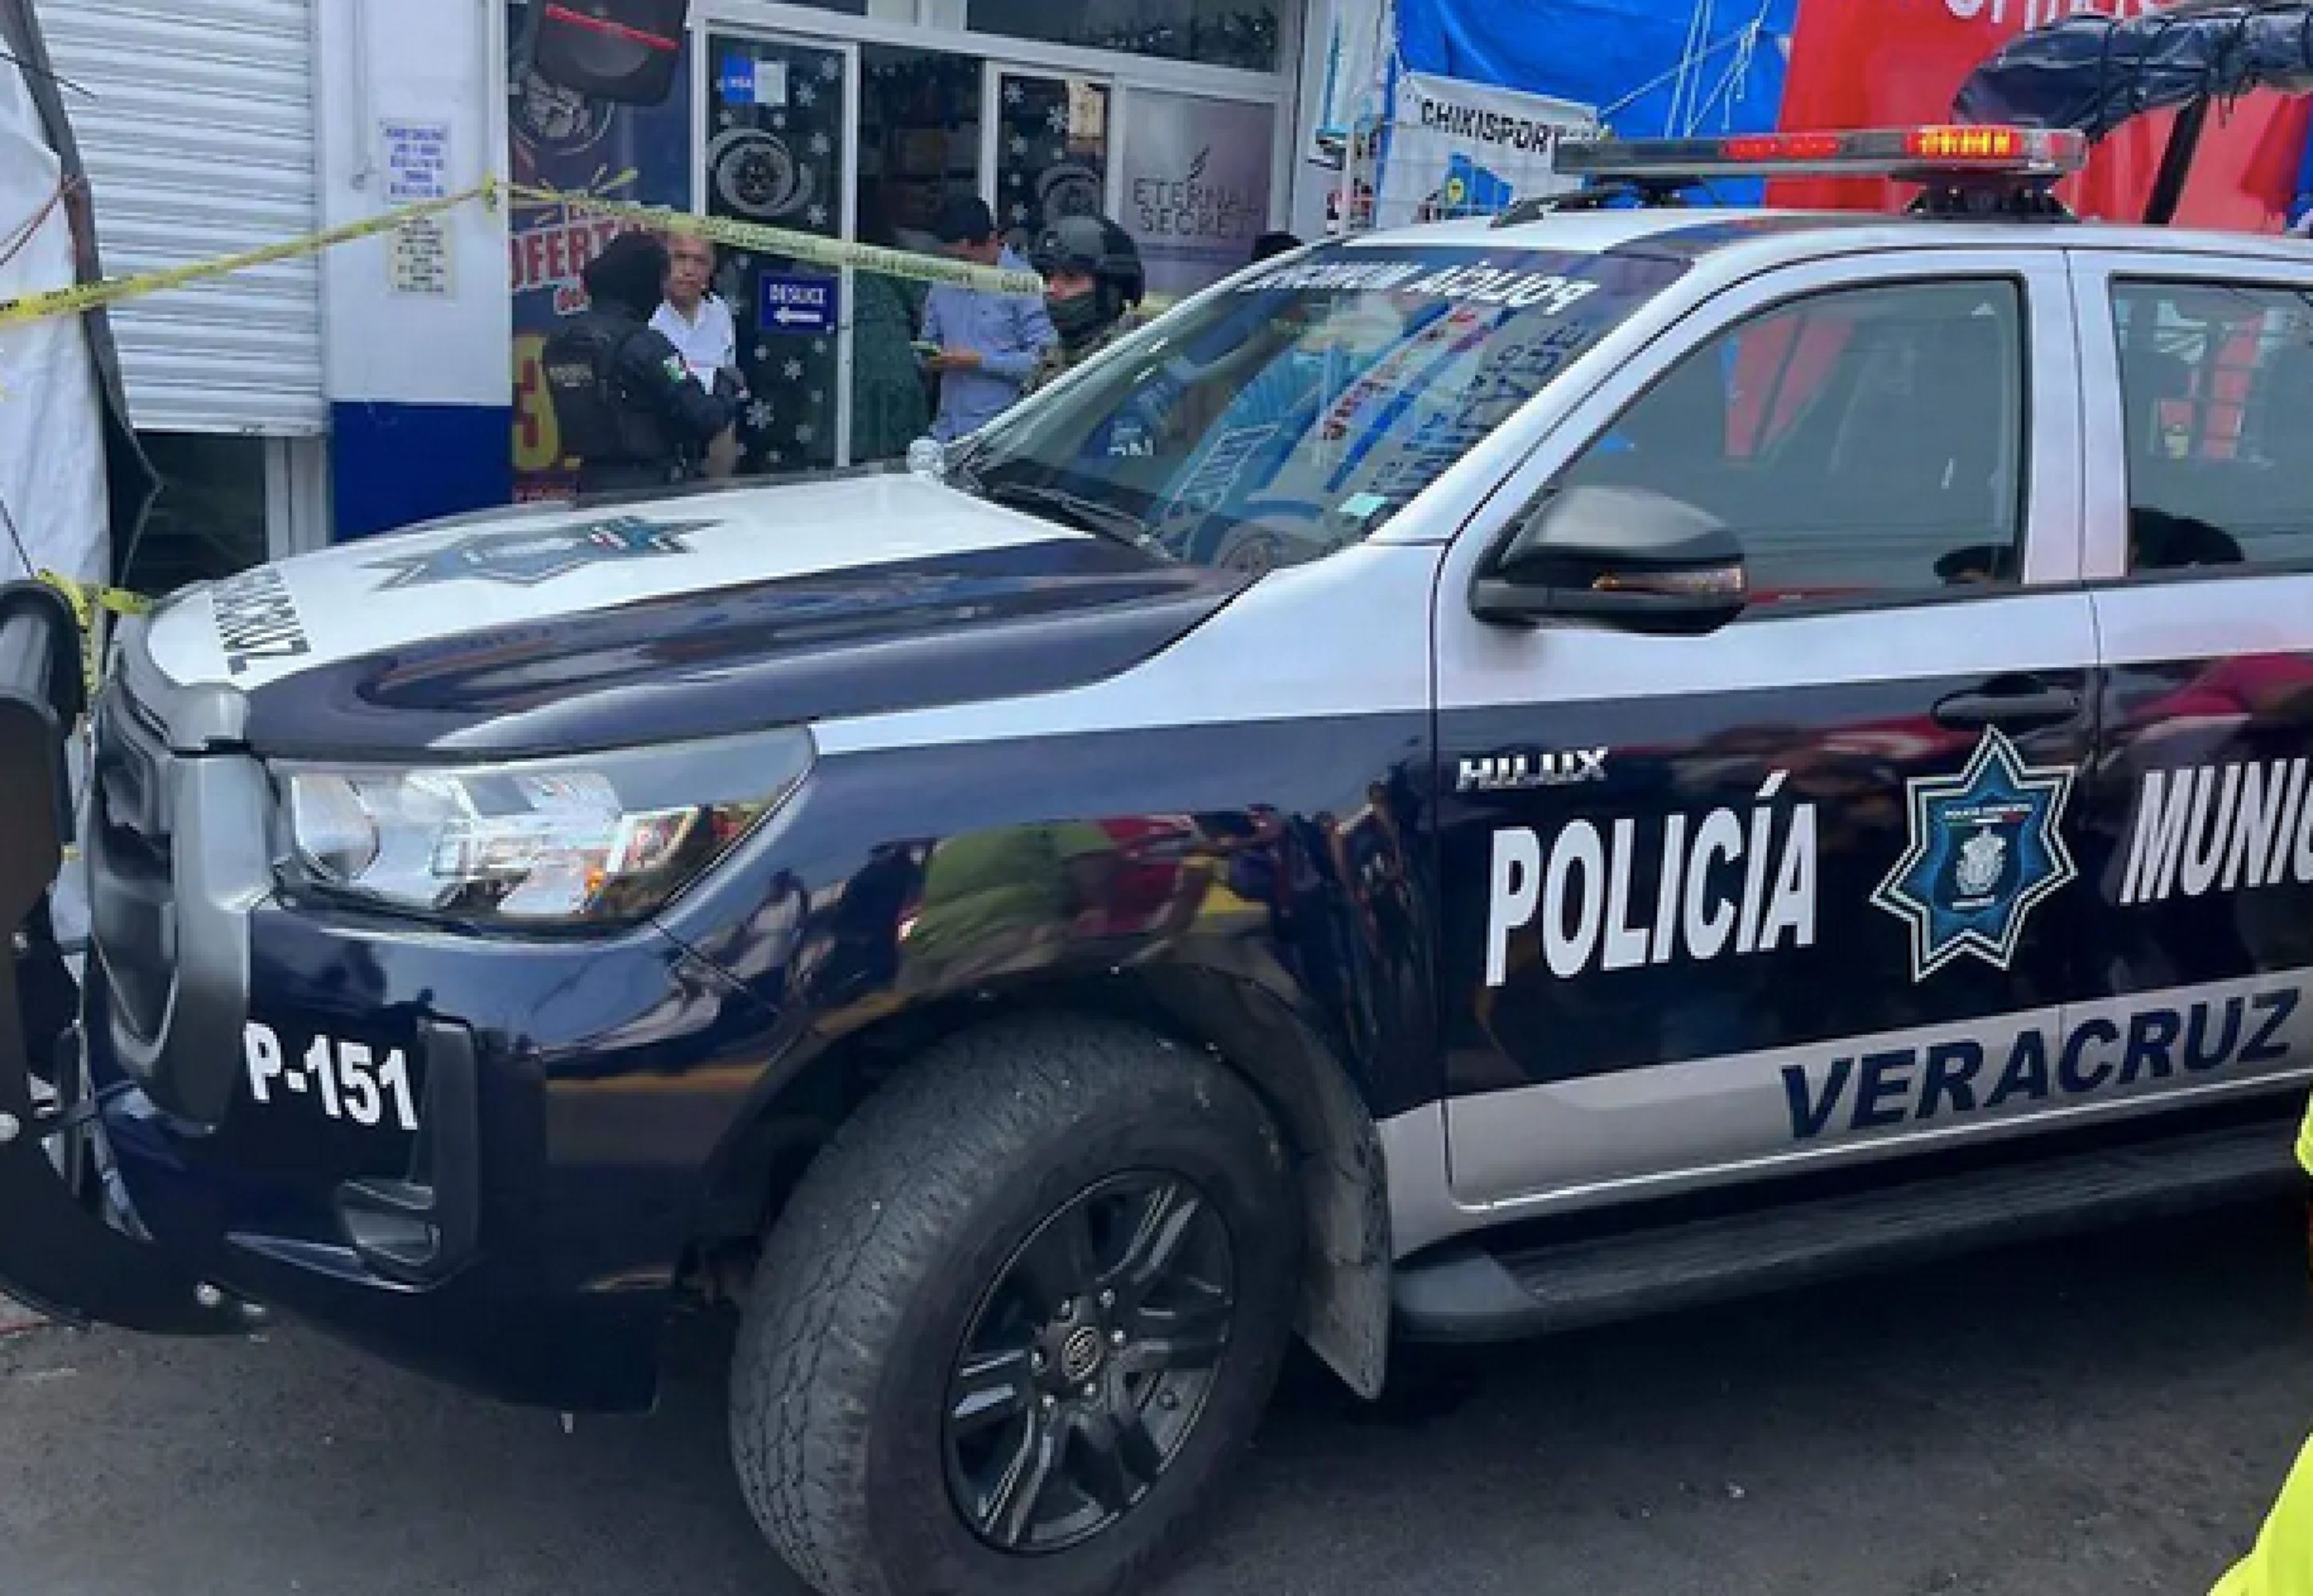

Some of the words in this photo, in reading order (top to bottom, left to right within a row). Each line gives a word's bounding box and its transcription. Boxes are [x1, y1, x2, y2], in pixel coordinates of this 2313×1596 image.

[1140, 208, 1255, 239] SECRET
[1457, 746, 1608, 792] HILUX
[1485, 769, 1817, 987] POLICÍA
[244, 1020, 418, 1131] P-151
[1781, 988, 2301, 1140] VERACRUZ
